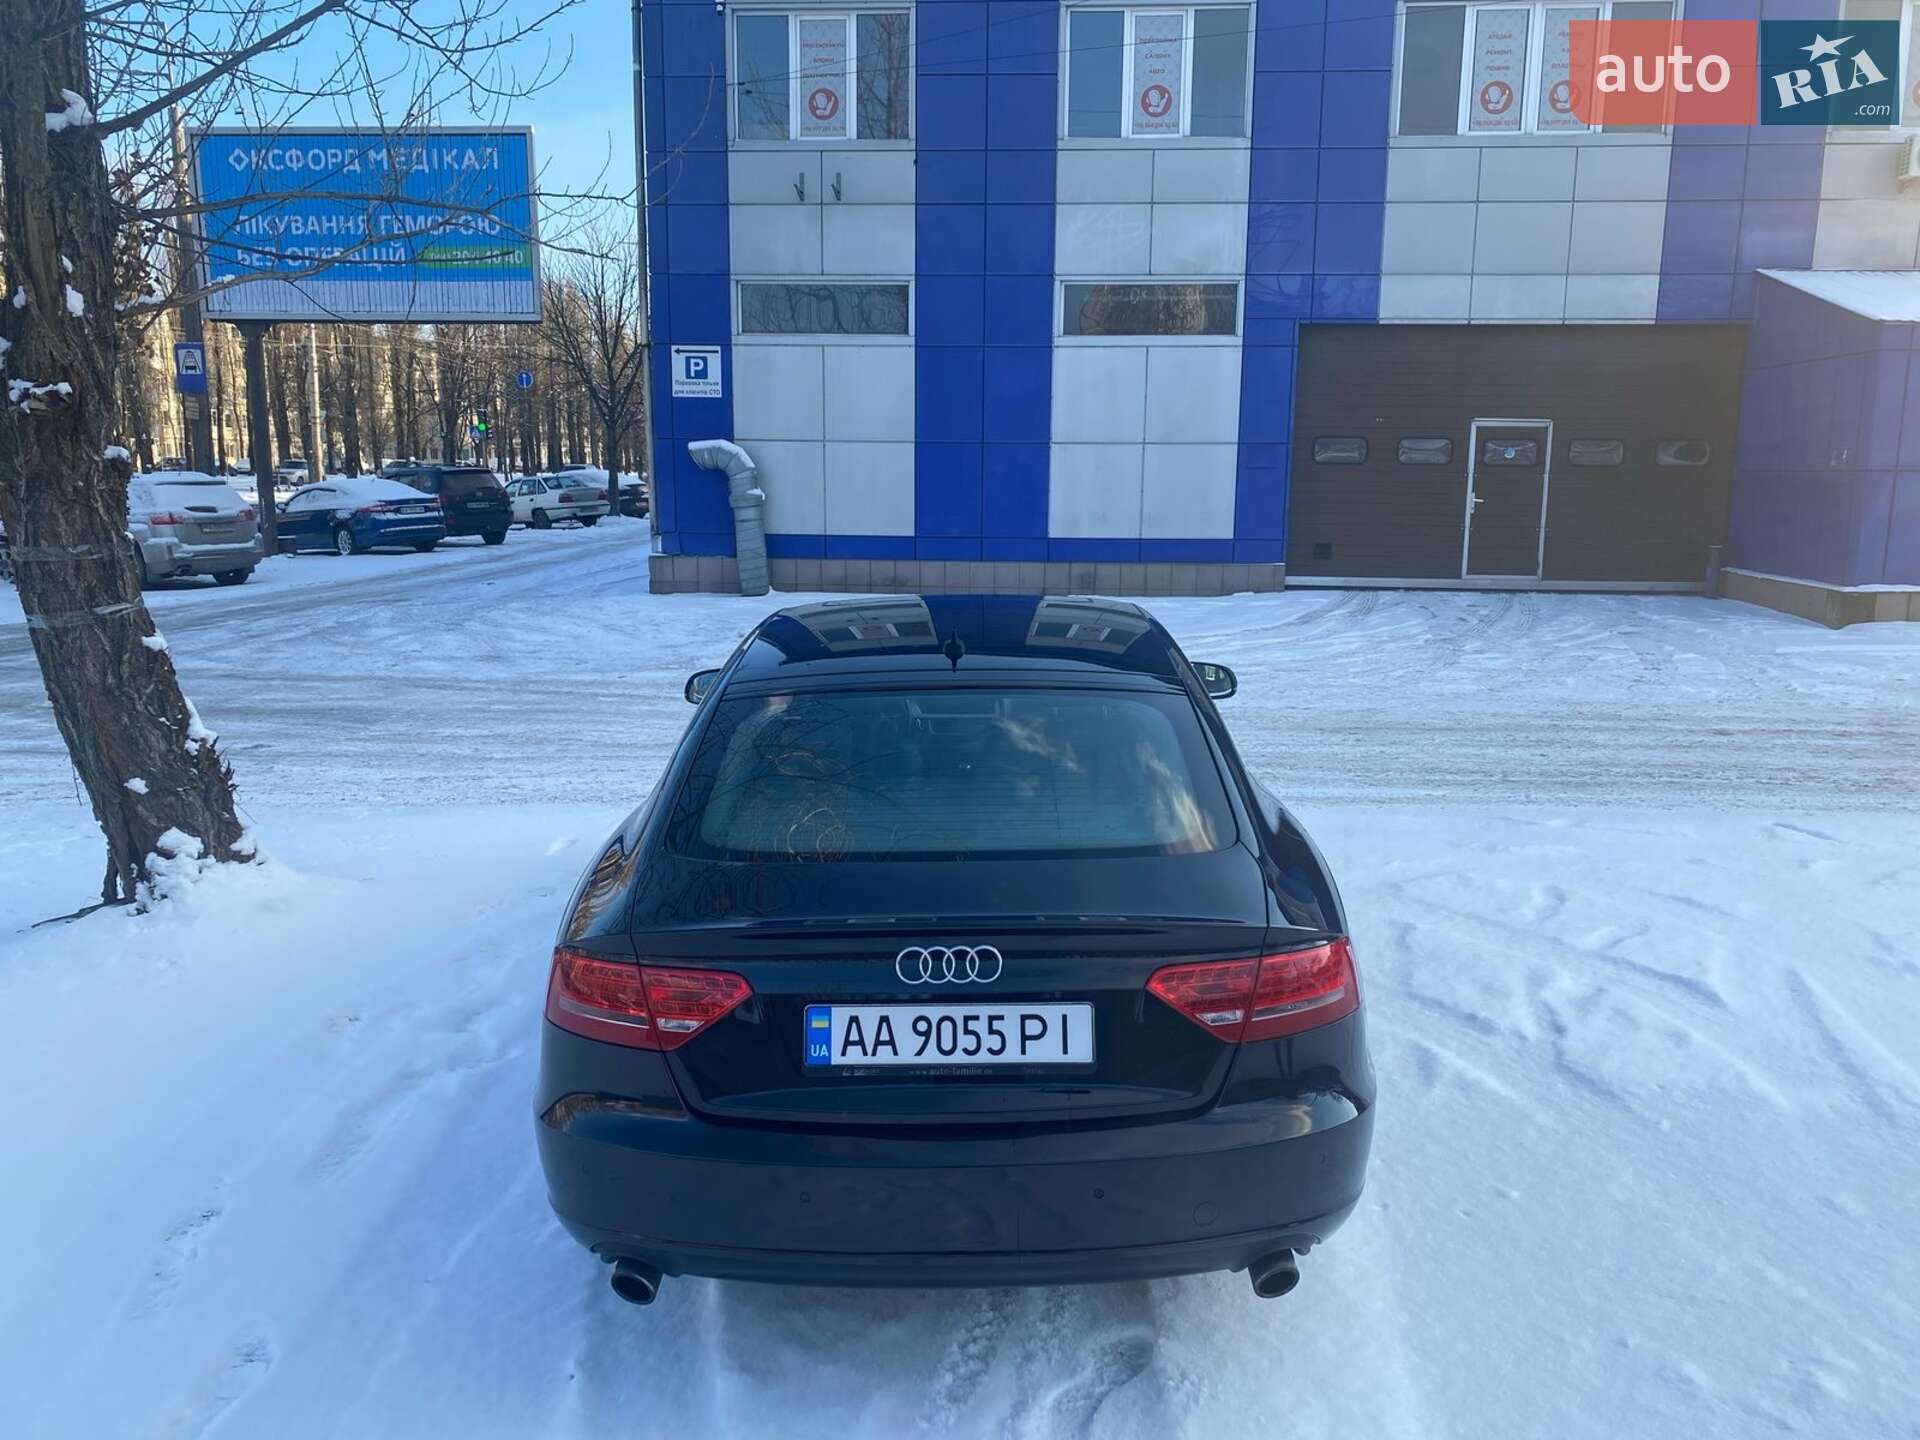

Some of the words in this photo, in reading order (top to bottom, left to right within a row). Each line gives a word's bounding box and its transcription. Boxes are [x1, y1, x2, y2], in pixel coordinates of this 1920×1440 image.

[228, 148, 361, 173] ОКСФОРД
[368, 147, 499, 174] МЕДІКАЛ
[690, 358, 704, 377] P
[840, 1015, 899, 1057] AA
[912, 1014, 1007, 1057] 9055
[811, 1044, 829, 1057] UA
